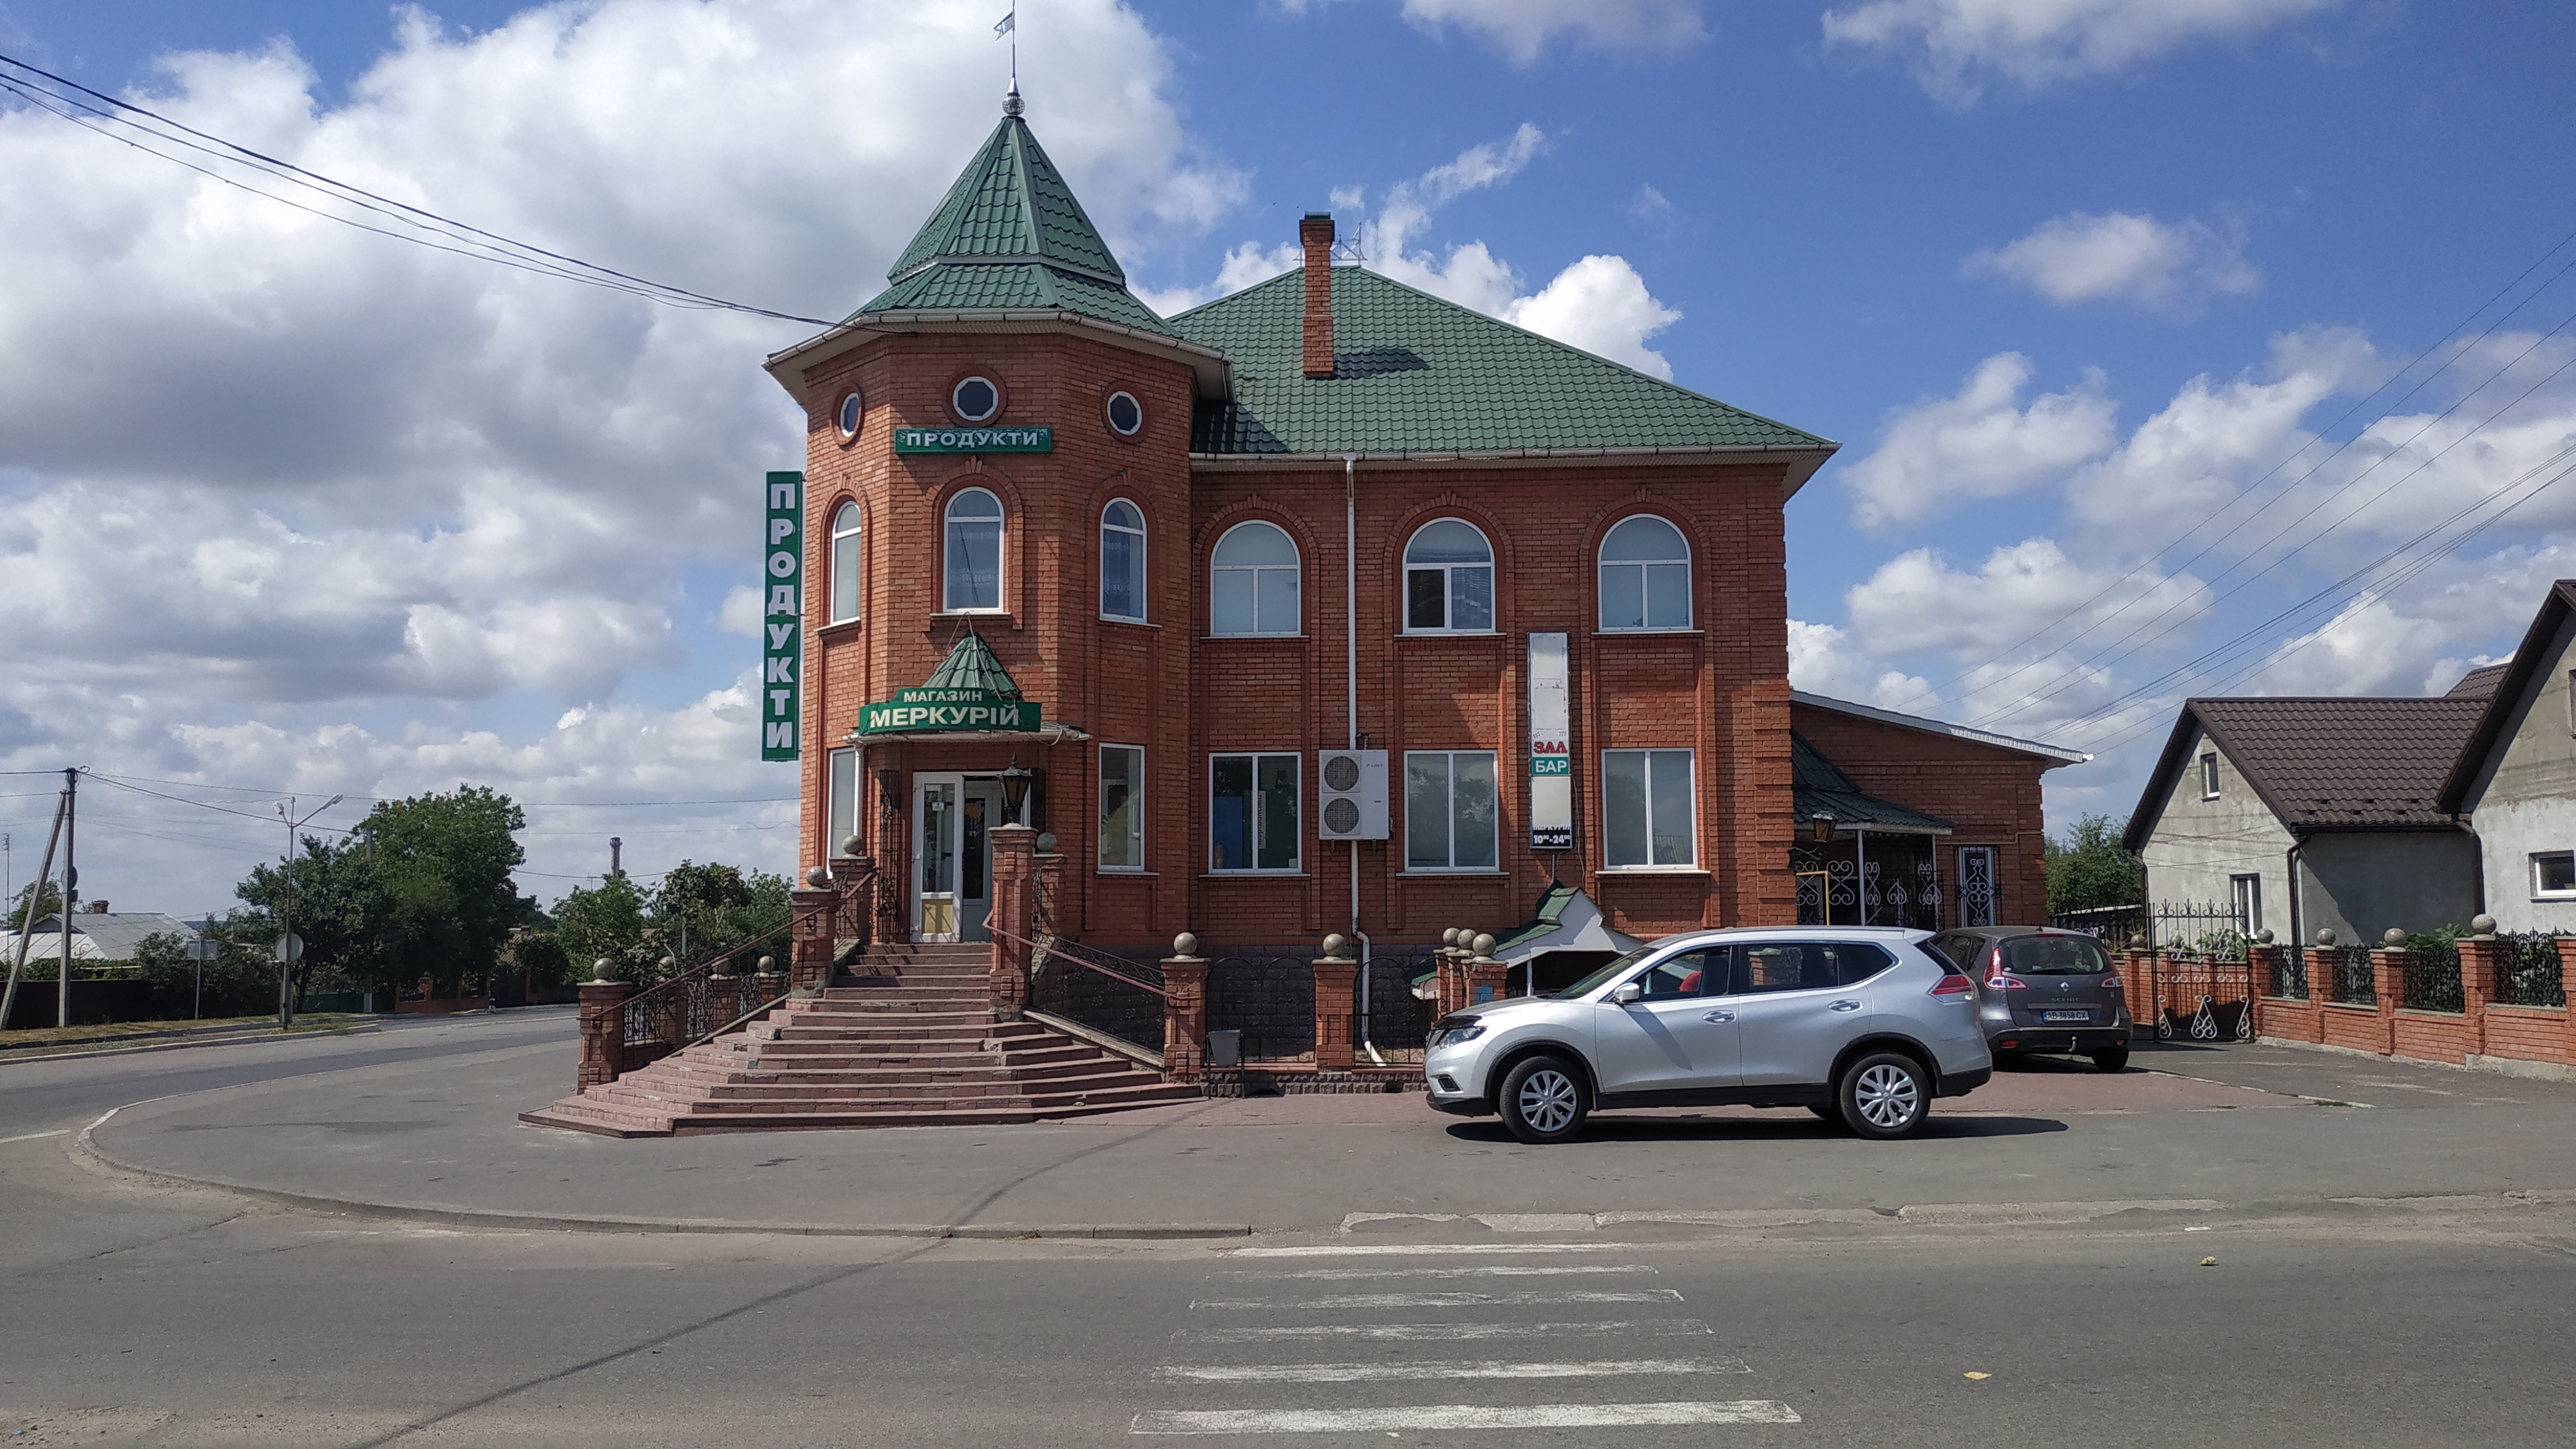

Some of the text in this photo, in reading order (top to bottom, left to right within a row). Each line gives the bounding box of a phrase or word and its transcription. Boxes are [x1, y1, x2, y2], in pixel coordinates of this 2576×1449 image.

[907, 432, 1038, 448] ПРОДУКТИ
[766, 483, 796, 749] ПРОДУКТИ
[904, 690, 983, 703] МАГАЗИН
[870, 703, 1019, 728] МЕРКУРІЙ
[1535, 760, 1567, 773] БАР
